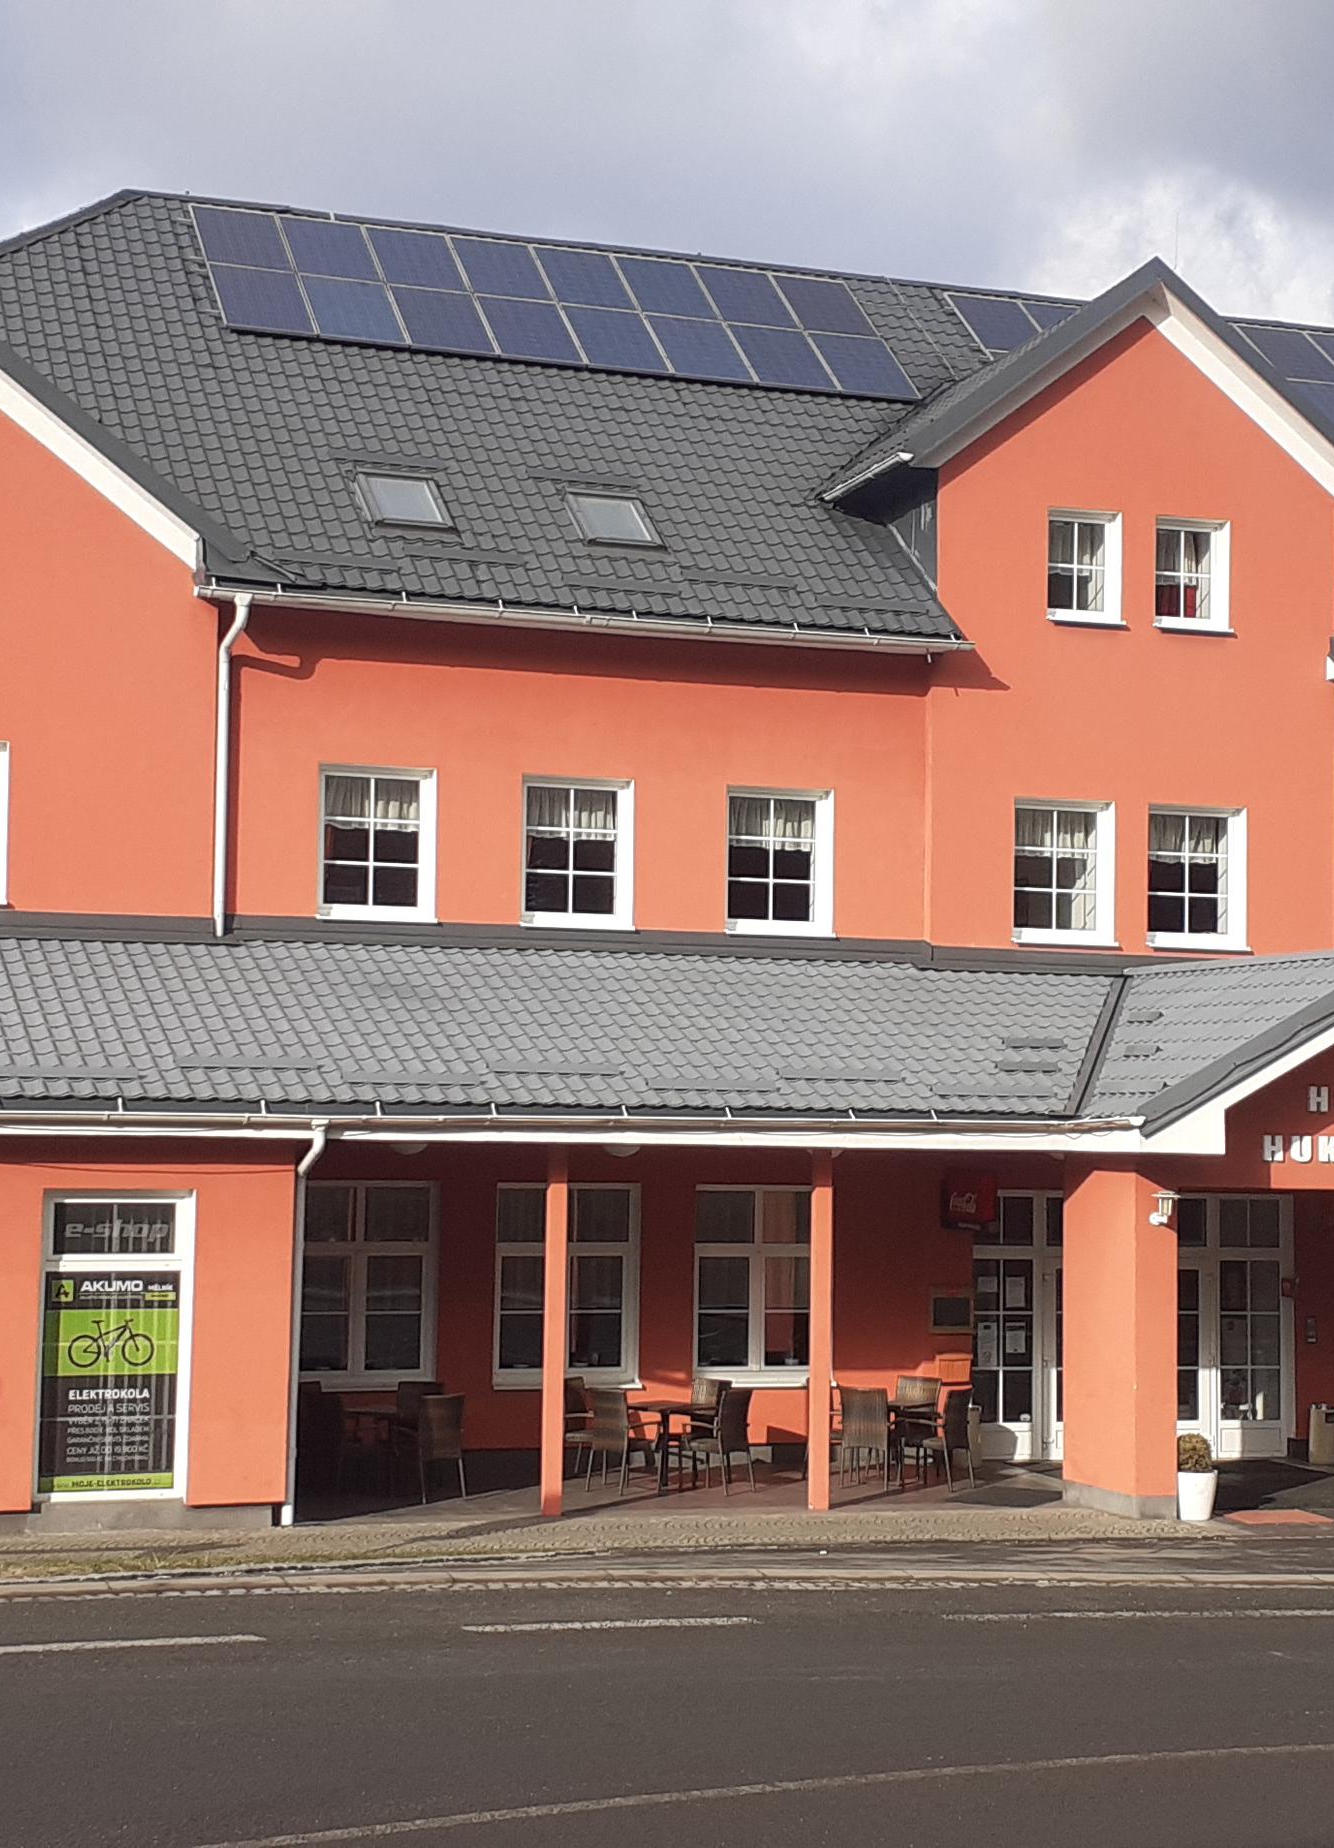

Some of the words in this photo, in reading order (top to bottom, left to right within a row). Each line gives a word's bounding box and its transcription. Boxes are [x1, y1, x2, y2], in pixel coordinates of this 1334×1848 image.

[65, 1216, 169, 1242] e-shop
[79, 1280, 144, 1292] AKUMO
[68, 1388, 150, 1400] ELEKTROKOLA
[67, 1404, 106, 1414] PRODEJ
[116, 1402, 150, 1413] SERVIS
